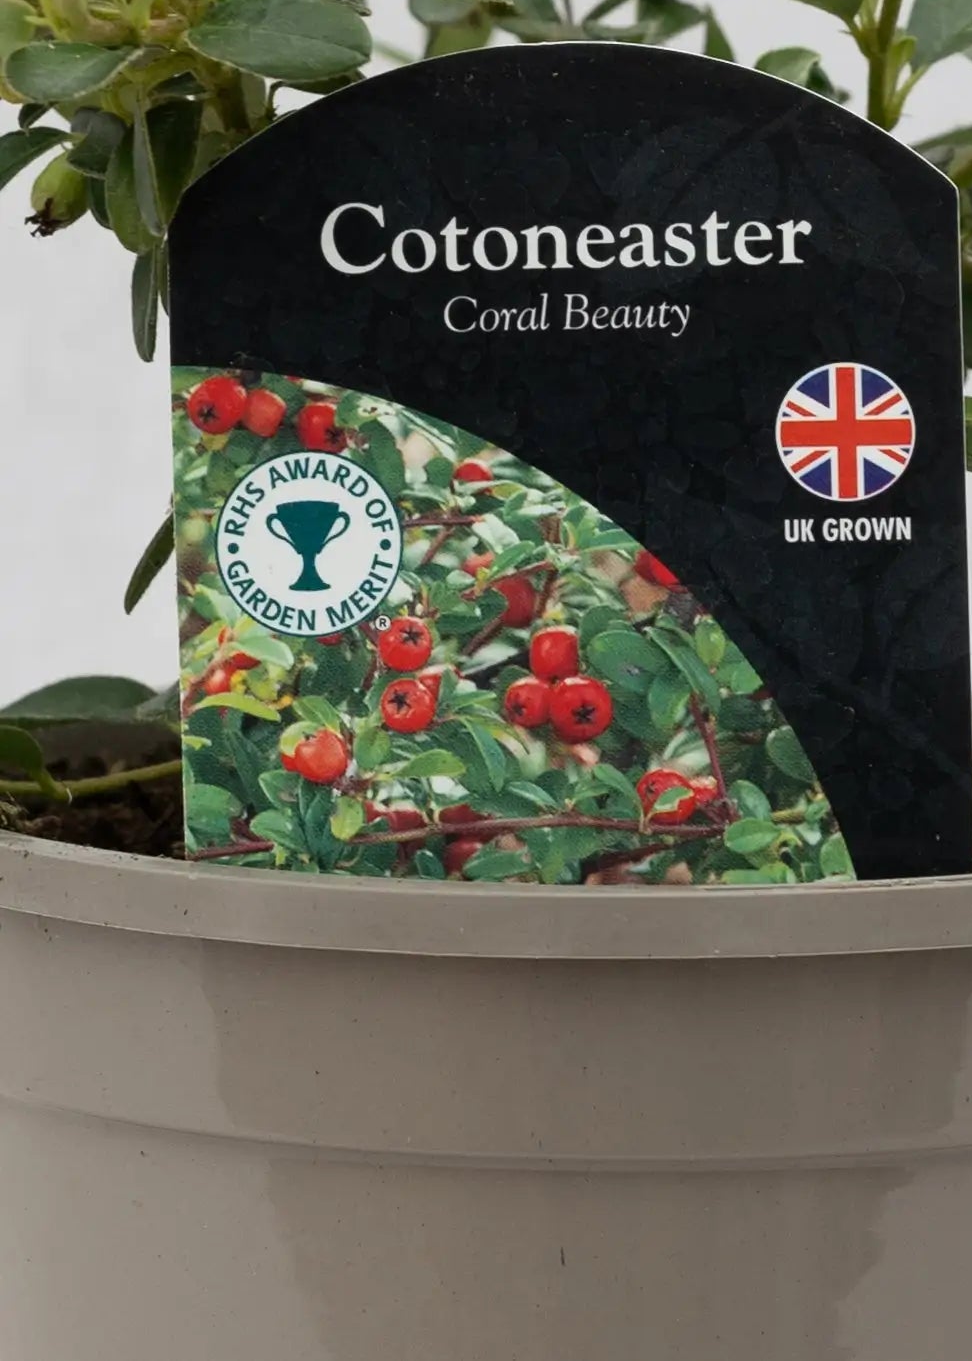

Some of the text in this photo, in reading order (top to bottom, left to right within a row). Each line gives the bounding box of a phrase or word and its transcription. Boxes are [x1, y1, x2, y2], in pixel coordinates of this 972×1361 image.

[320, 202, 813, 275] Cotoneaster
[443, 293, 691, 337] Coral Beauty
[224, 456, 394, 537] RHS AWARD OF
[783, 516, 912, 543] UK GROWN
[227, 553, 394, 631] GARDEN MERIT
